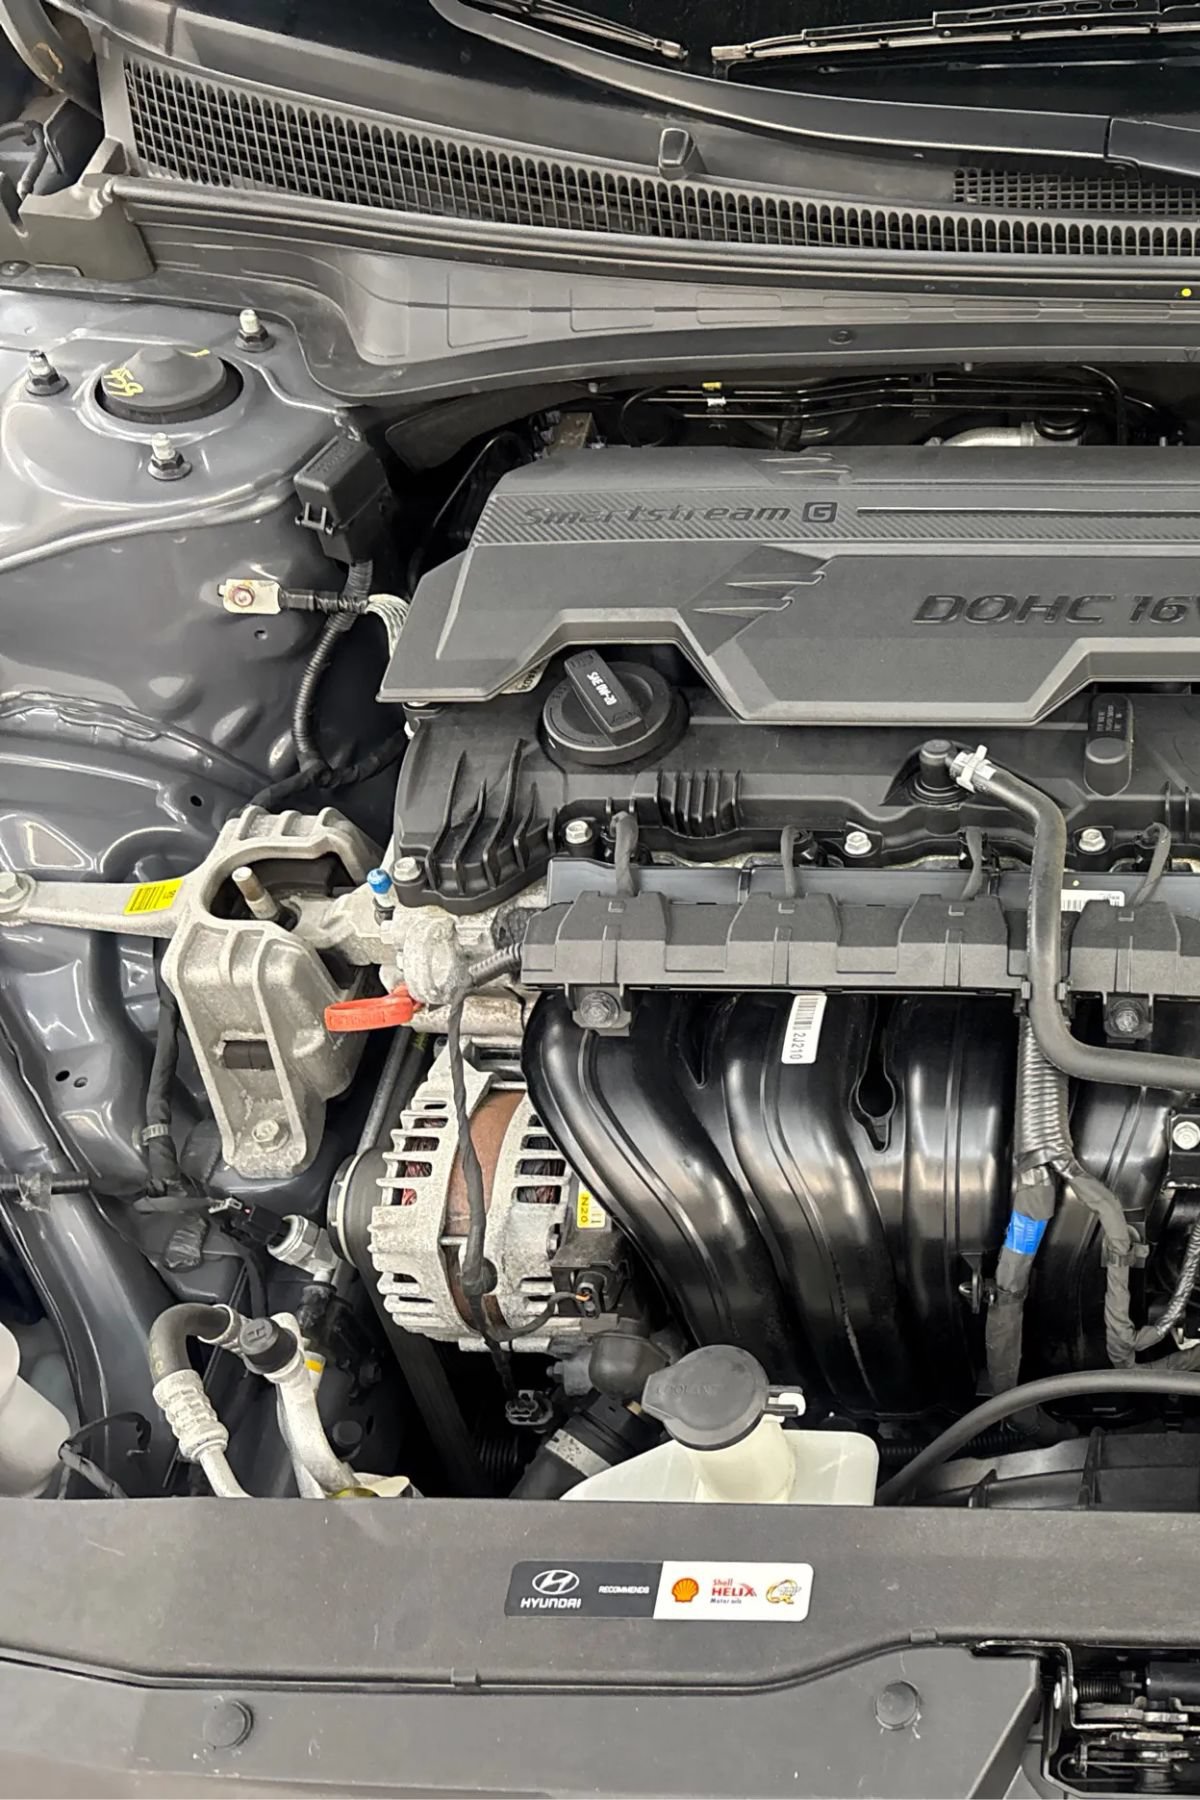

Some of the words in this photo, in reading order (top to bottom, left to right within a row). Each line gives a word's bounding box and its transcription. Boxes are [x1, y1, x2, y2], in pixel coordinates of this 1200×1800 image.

[517, 504, 791, 526] Smartstream
[911, 593, 1115, 625] DOHC
[586, 671, 604, 687] SAE
[580, 1196, 589, 1223] N20
[598, 1585, 650, 1594] RECOMMENDS
[713, 1578, 733, 1587] Shell
[711, 1585, 756, 1597] HELIX
[520, 1598, 582, 1609] HYUNDAI
